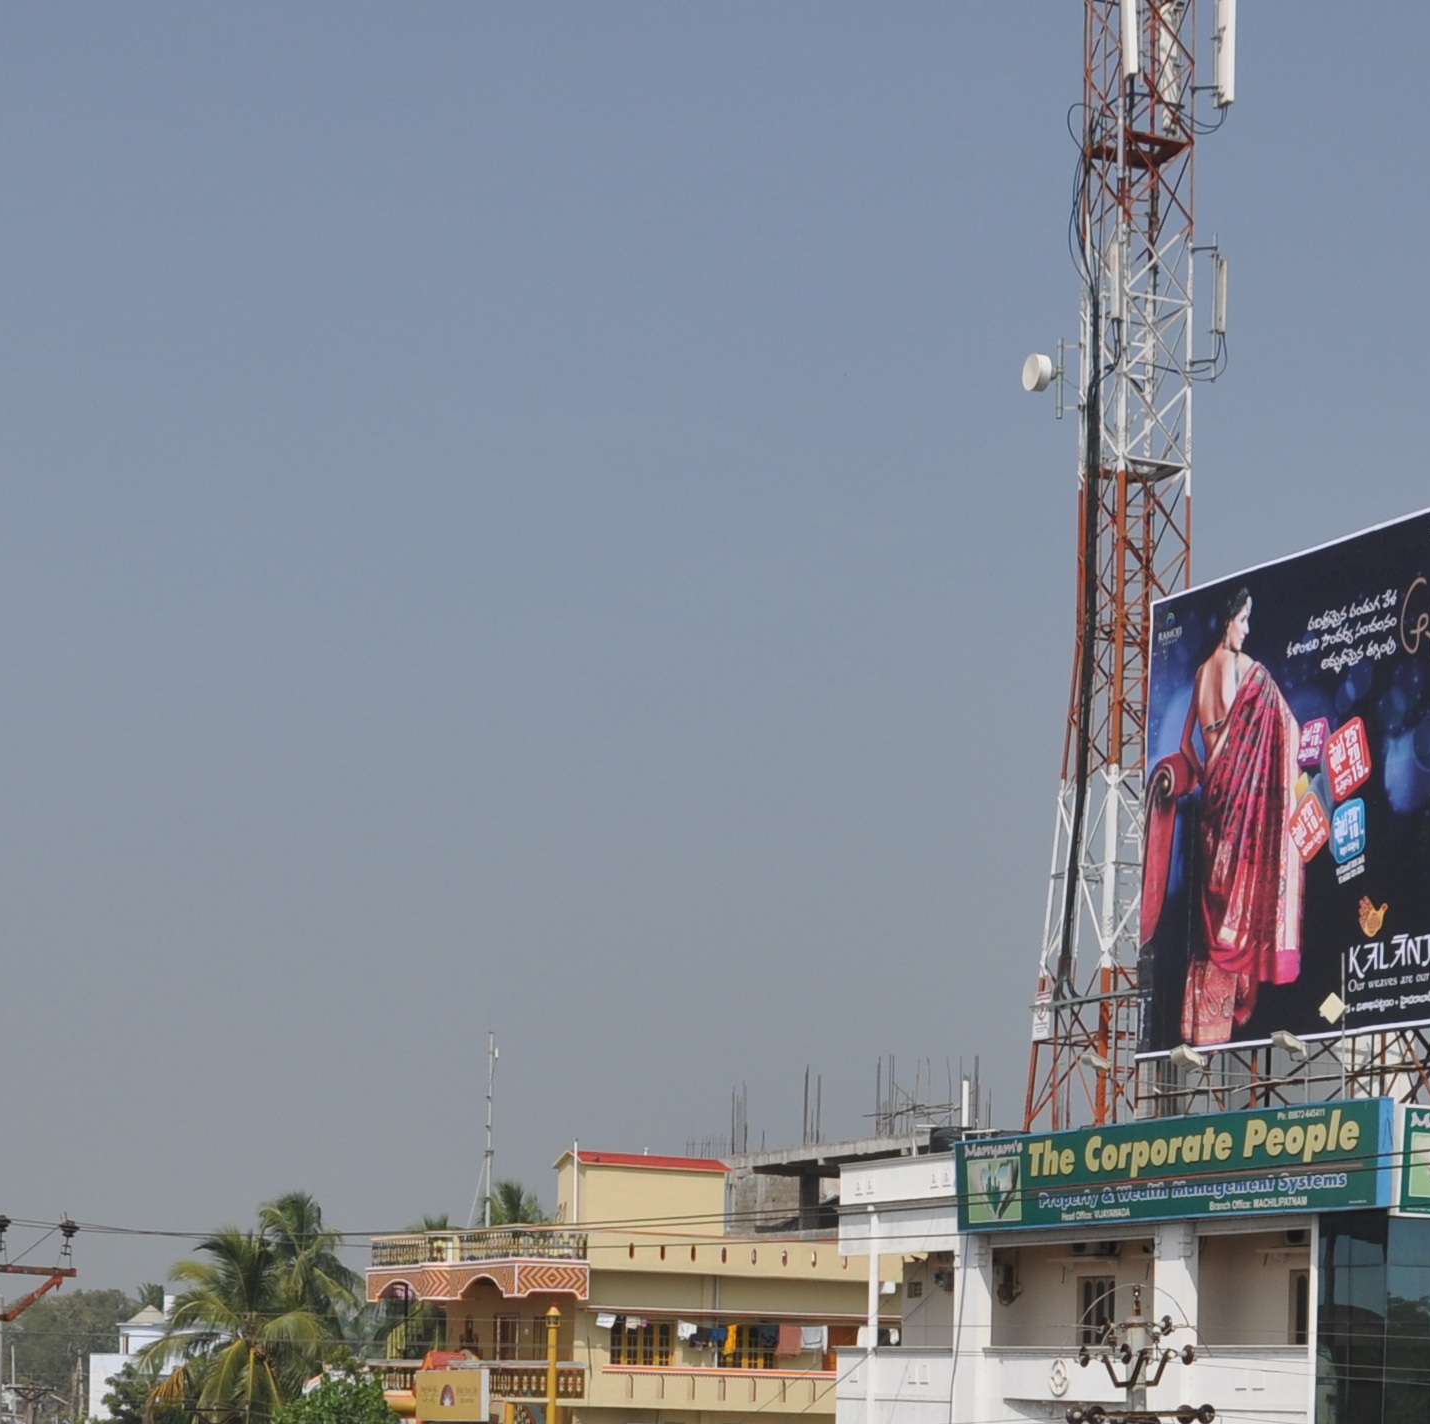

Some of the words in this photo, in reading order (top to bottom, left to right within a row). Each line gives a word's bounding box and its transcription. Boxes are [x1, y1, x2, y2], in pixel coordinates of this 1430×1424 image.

[1348, 979, 1365, 992] Our
[1400, 975, 1413, 984] are
[1416, 973, 1430, 982] our
[1028, 1139, 1075, 1177] The
[1085, 1127, 1233, 1178] Corporate
[1243, 1109, 1360, 1162] People
[1038, 1187, 1098, 1208] Property
[1101, 1187, 1114, 1202] &
[1116, 1181, 1168, 1201] Wealth
[1172, 1175, 1275, 1202] Management
[1278, 1172, 1347, 1192] Systems
[1209, 1201, 1229, 1211] Branch
